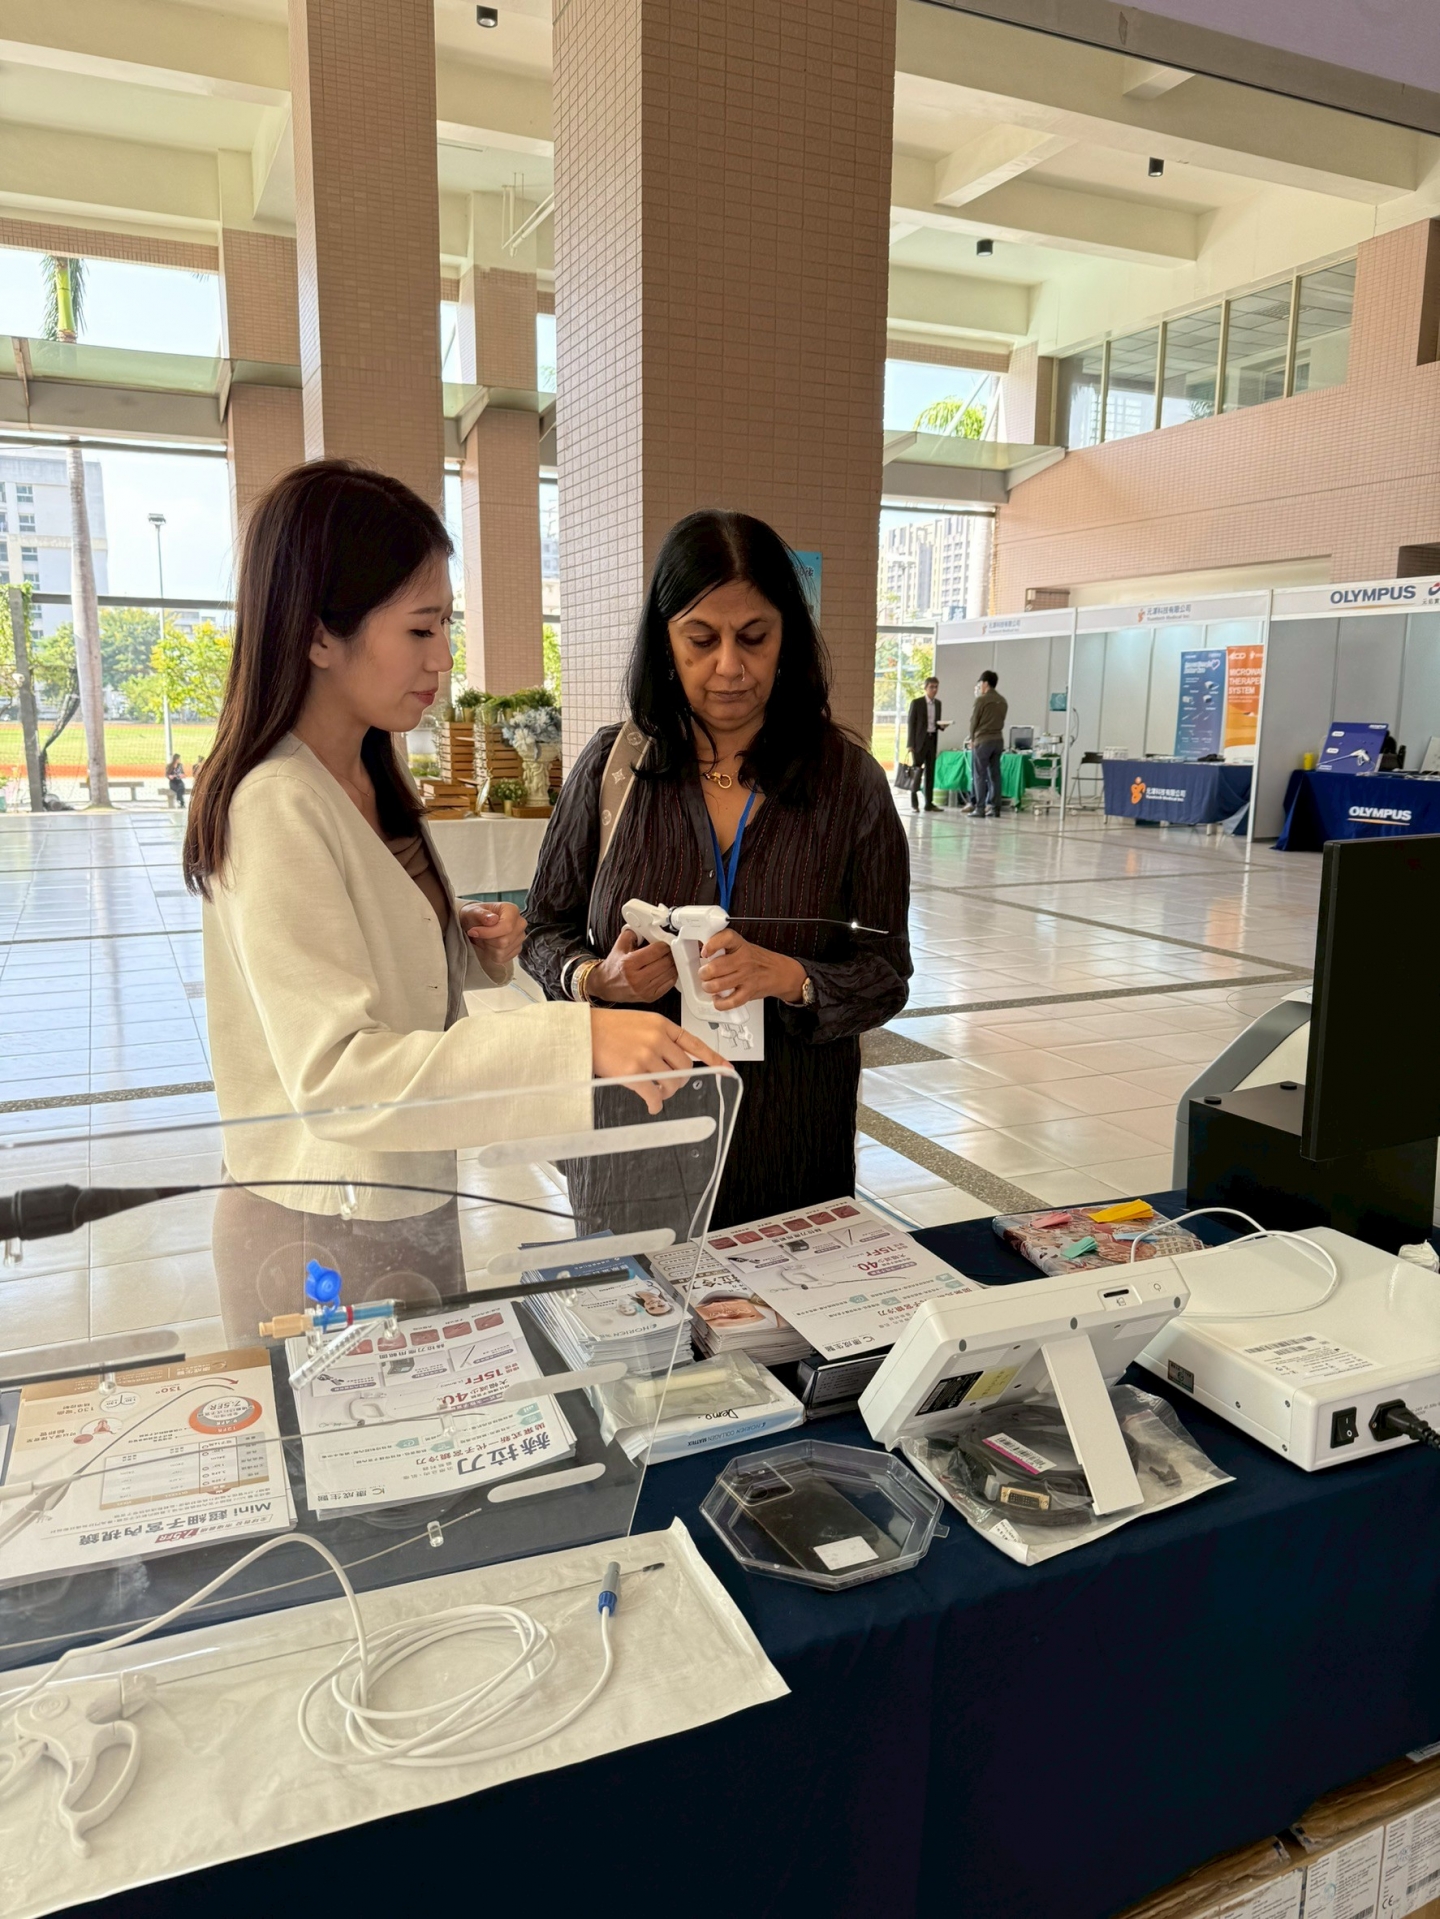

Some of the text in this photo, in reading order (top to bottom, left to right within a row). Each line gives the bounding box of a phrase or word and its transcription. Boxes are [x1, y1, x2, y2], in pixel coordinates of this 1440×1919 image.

[1330, 585, 1416, 604] OLYMPUS
[1229, 686, 1255, 694] SYSTEM
[1349, 806, 1412, 821] OLYMPUS
[613, 1325, 650, 1337] HORIEN
[464, 1368, 503, 1386] 15Fr
[470, 1378, 508, 1395] 大幅減少
[687, 1437, 708, 1447] MATRIX
[708, 1430, 735, 1441] COLLAGEN
[457, 1432, 551, 1476] 赫拉刀
[317, 1490, 367, 1502] 康成生醫
[234, 1502, 272, 1517] Mini
[78, 1510, 228, 1546] 超細子宮內視鏡
